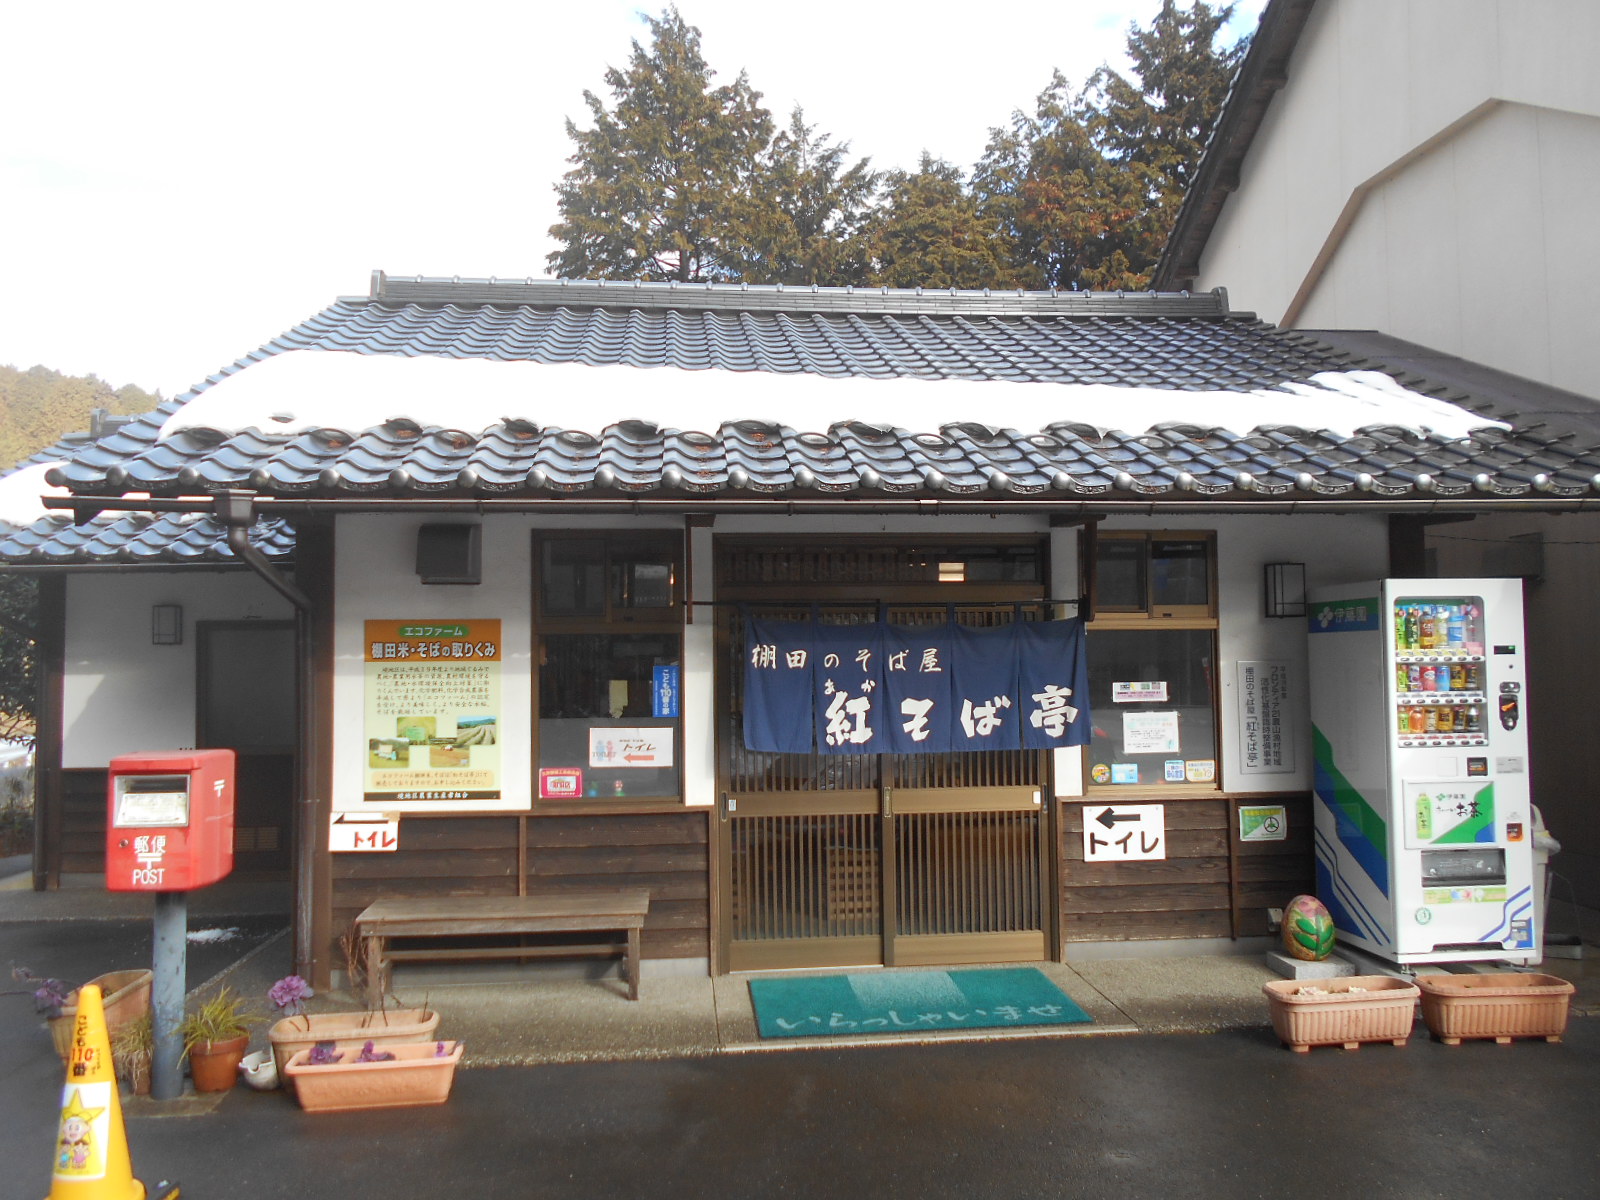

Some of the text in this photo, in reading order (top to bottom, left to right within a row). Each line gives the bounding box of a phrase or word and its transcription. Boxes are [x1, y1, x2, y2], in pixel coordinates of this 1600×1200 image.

[404, 627, 463, 637] エコファーム
[371, 642, 496, 659] 棚田米・そばの取りくみ
[751, 644, 942, 672] 棚田のそば屋
[824, 678, 876, 696] あか
[825, 684, 1079, 746] 紅そば亭
[623, 743, 657, 752] トイレ
[134, 835, 167, 853] 郵便
[353, 830, 397, 848] トイレ
[1090, 831, 1160, 855] トイレ
[132, 868, 165, 885] POST
[775, 1003, 1063, 1030] いらっしゃいませ
